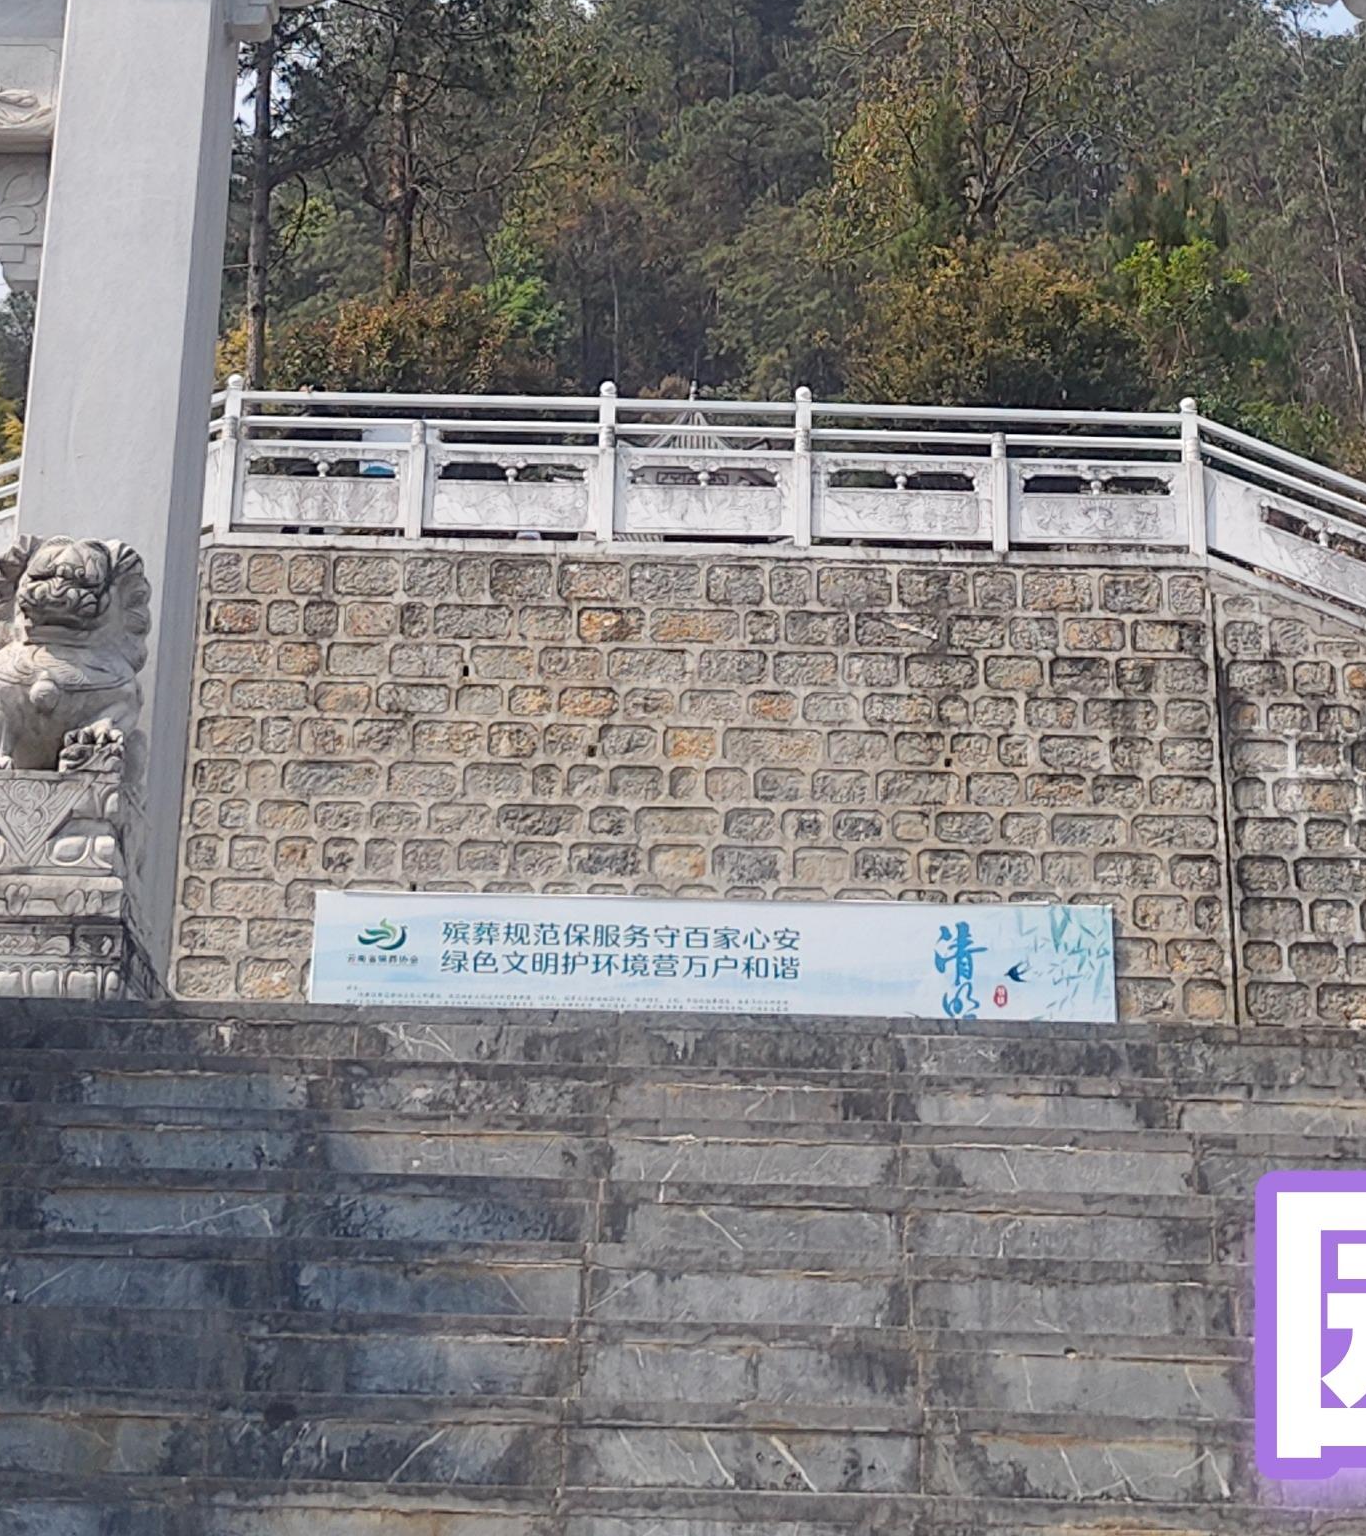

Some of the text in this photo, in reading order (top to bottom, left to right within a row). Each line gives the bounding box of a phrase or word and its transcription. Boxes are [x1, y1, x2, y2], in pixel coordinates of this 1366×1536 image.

[441, 920, 801, 952] 殡葬规范保服务守百家心安
[440, 949, 801, 980] 绿色文明护环境营万户和谐
